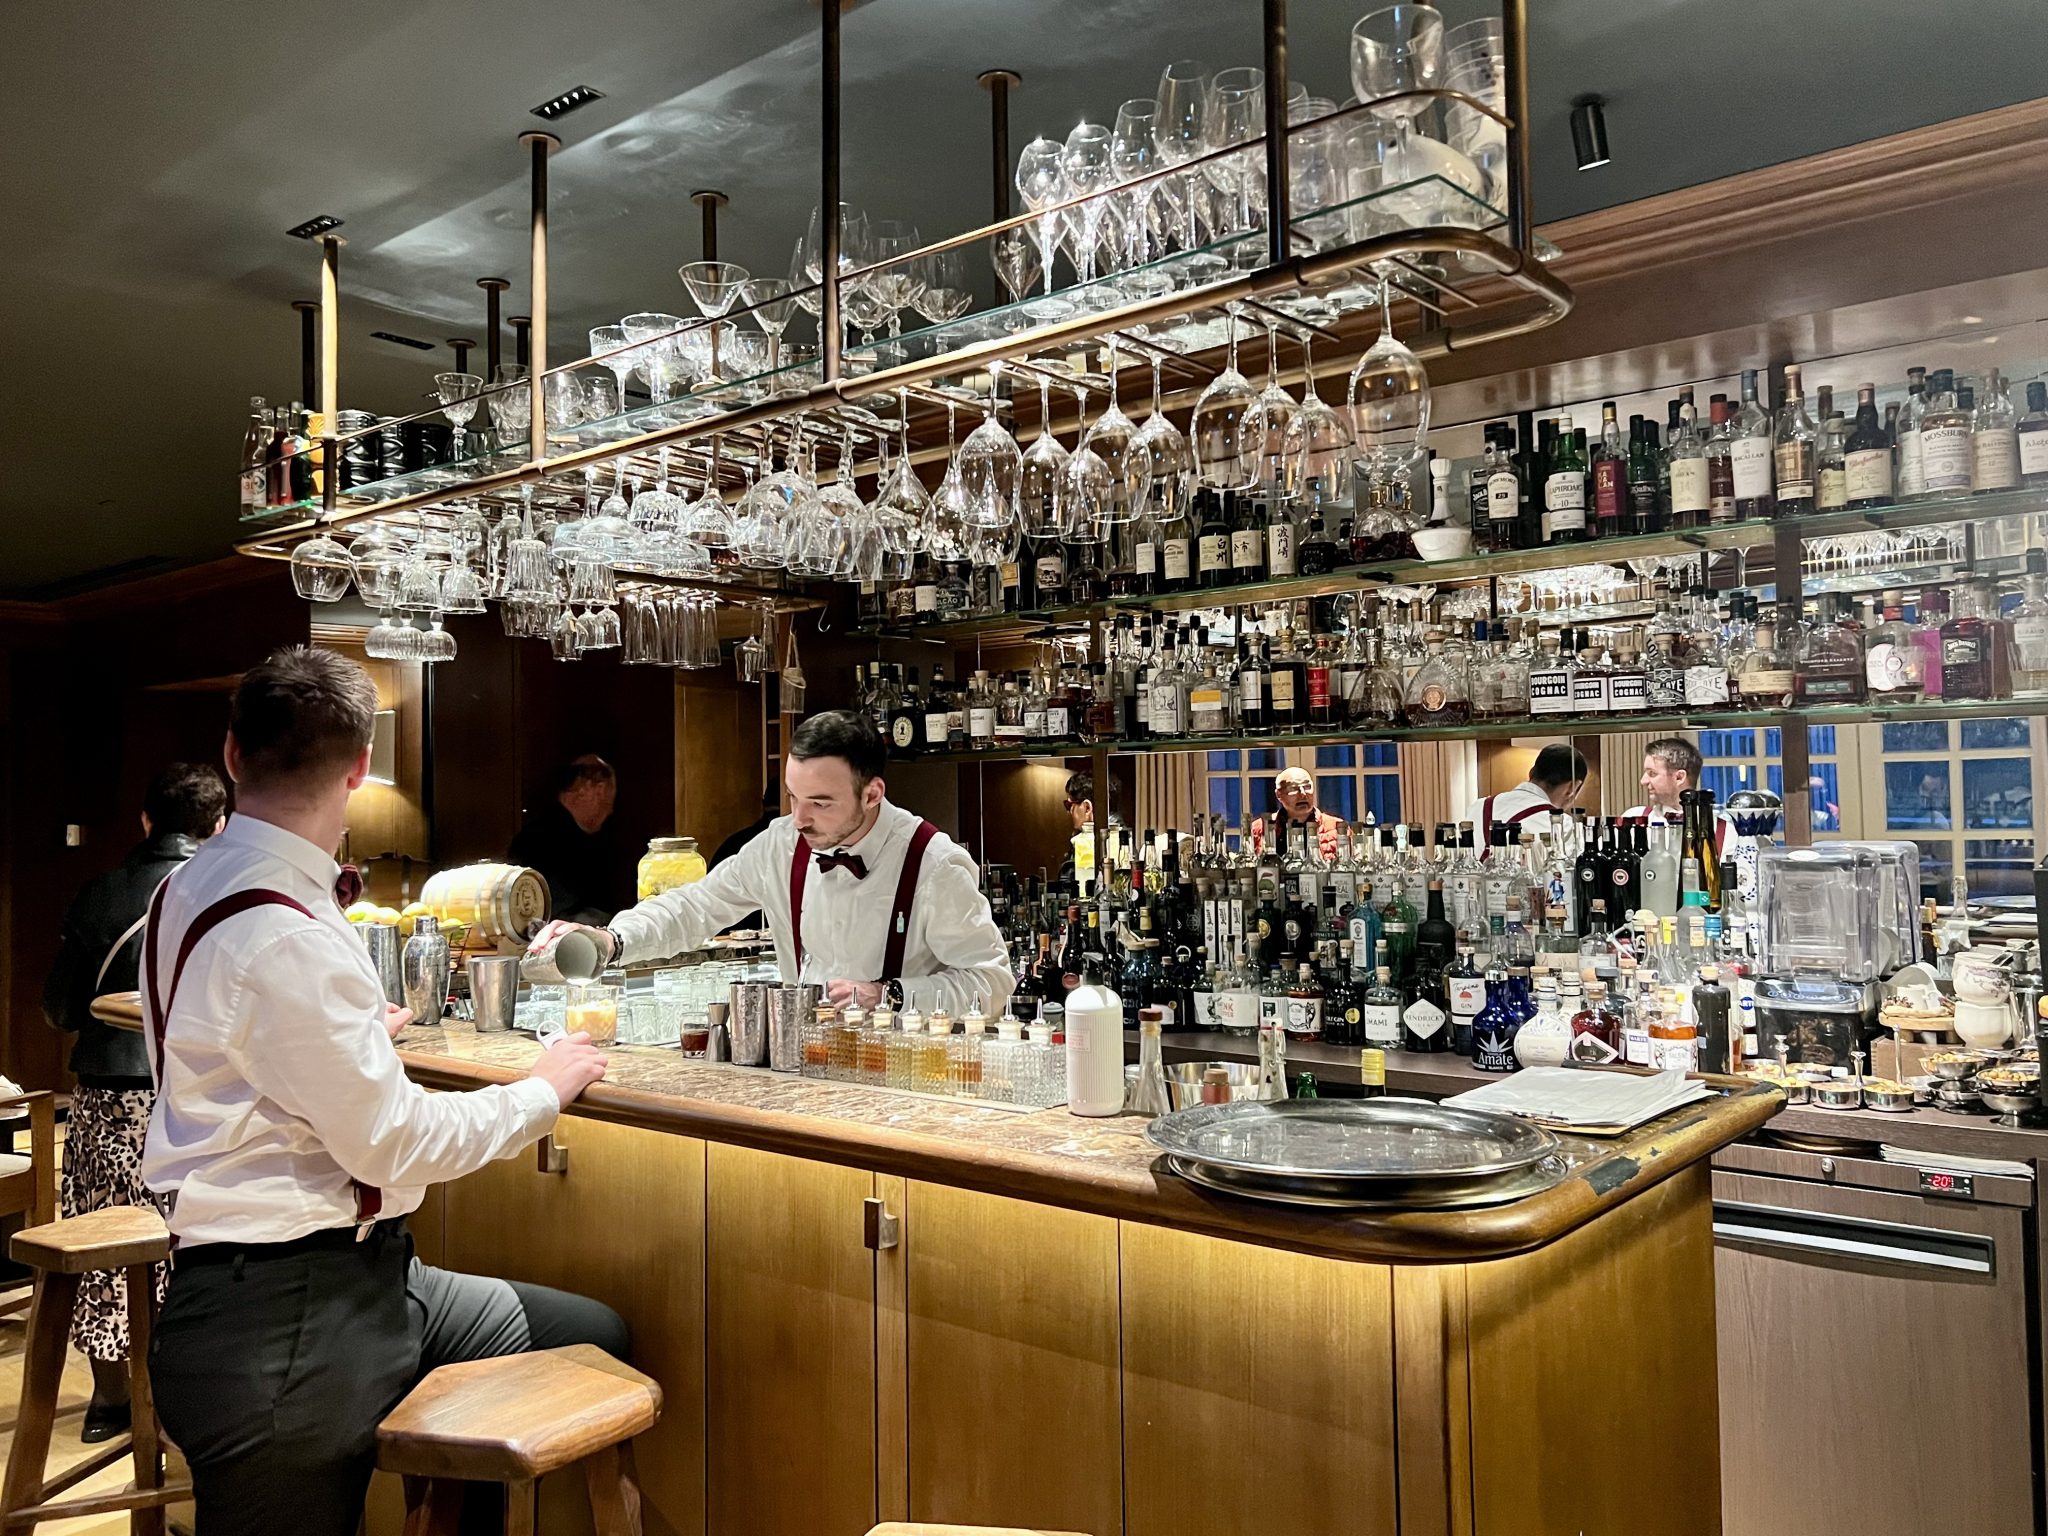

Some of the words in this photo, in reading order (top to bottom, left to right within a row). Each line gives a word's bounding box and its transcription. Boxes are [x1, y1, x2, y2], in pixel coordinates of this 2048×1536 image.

[1924, 429, 1968, 442] MOSSBURN
[1561, 499, 1569, 507] 10
[1531, 675, 1566, 686] BOURGOIN
[1614, 679, 1643, 688] BOURGOIN
[1531, 686, 1566, 696] COGNAC
[1614, 688, 1643, 696] COGNAC
